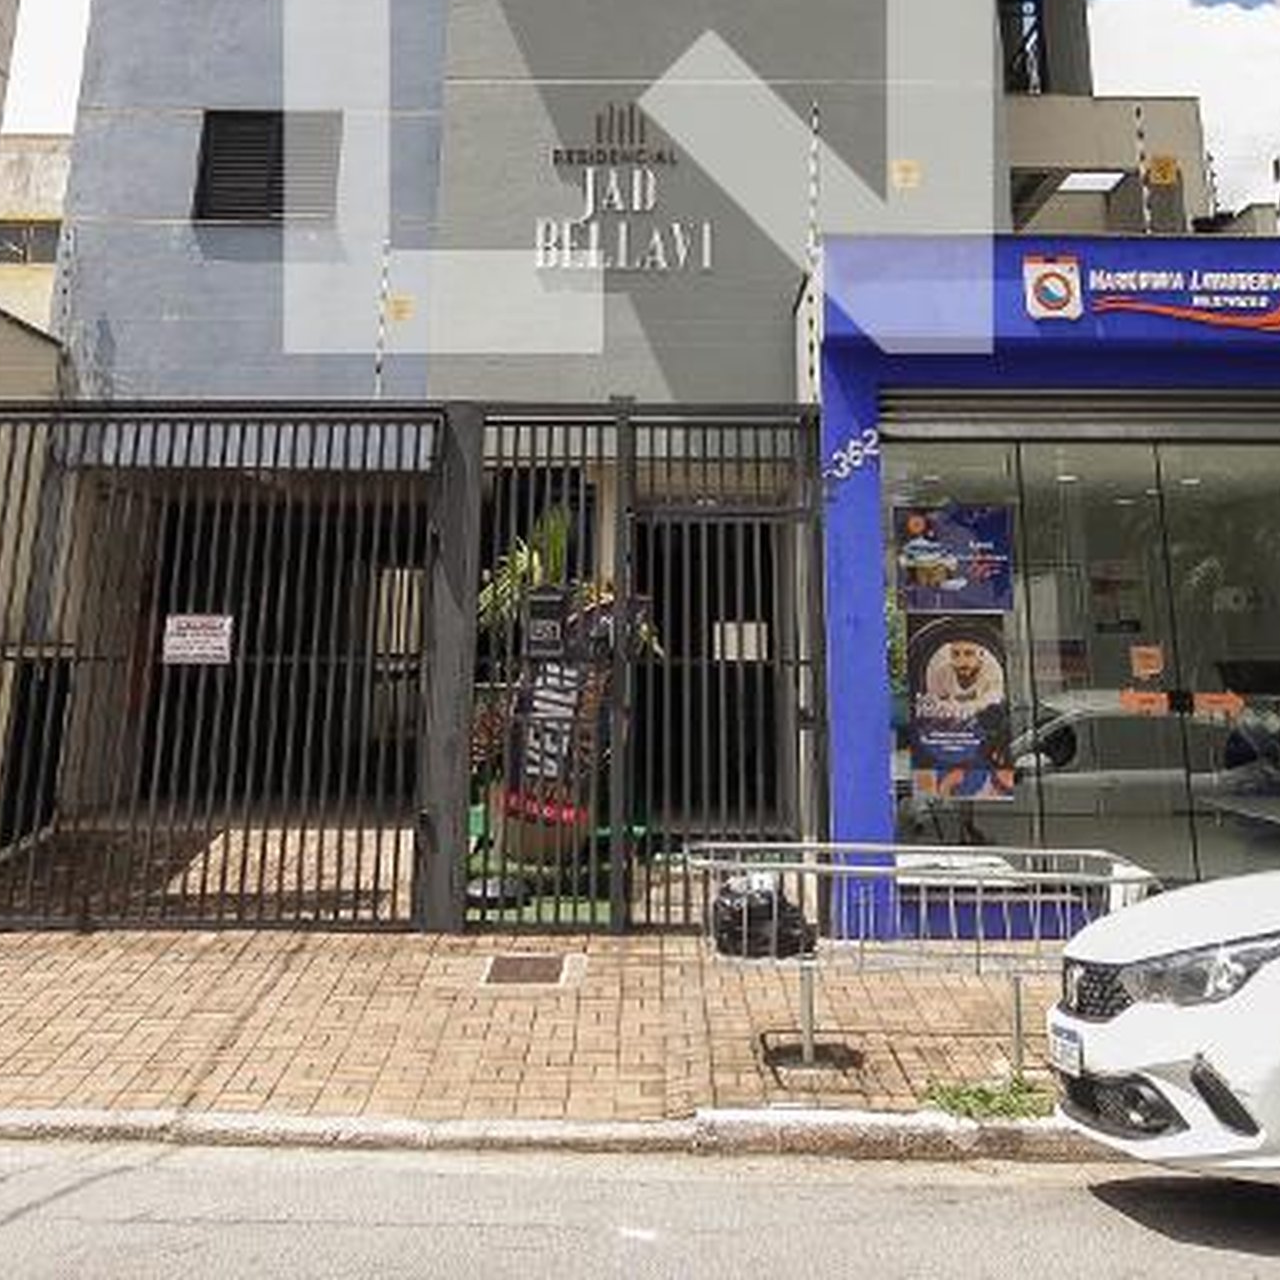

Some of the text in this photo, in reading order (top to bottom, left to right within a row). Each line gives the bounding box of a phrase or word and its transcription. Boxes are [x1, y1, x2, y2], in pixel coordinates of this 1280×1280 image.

[552, 148, 678, 165] RESIDENCIAL
[573, 166, 658, 224] JAD
[534, 219, 711, 268] BELLAVI
